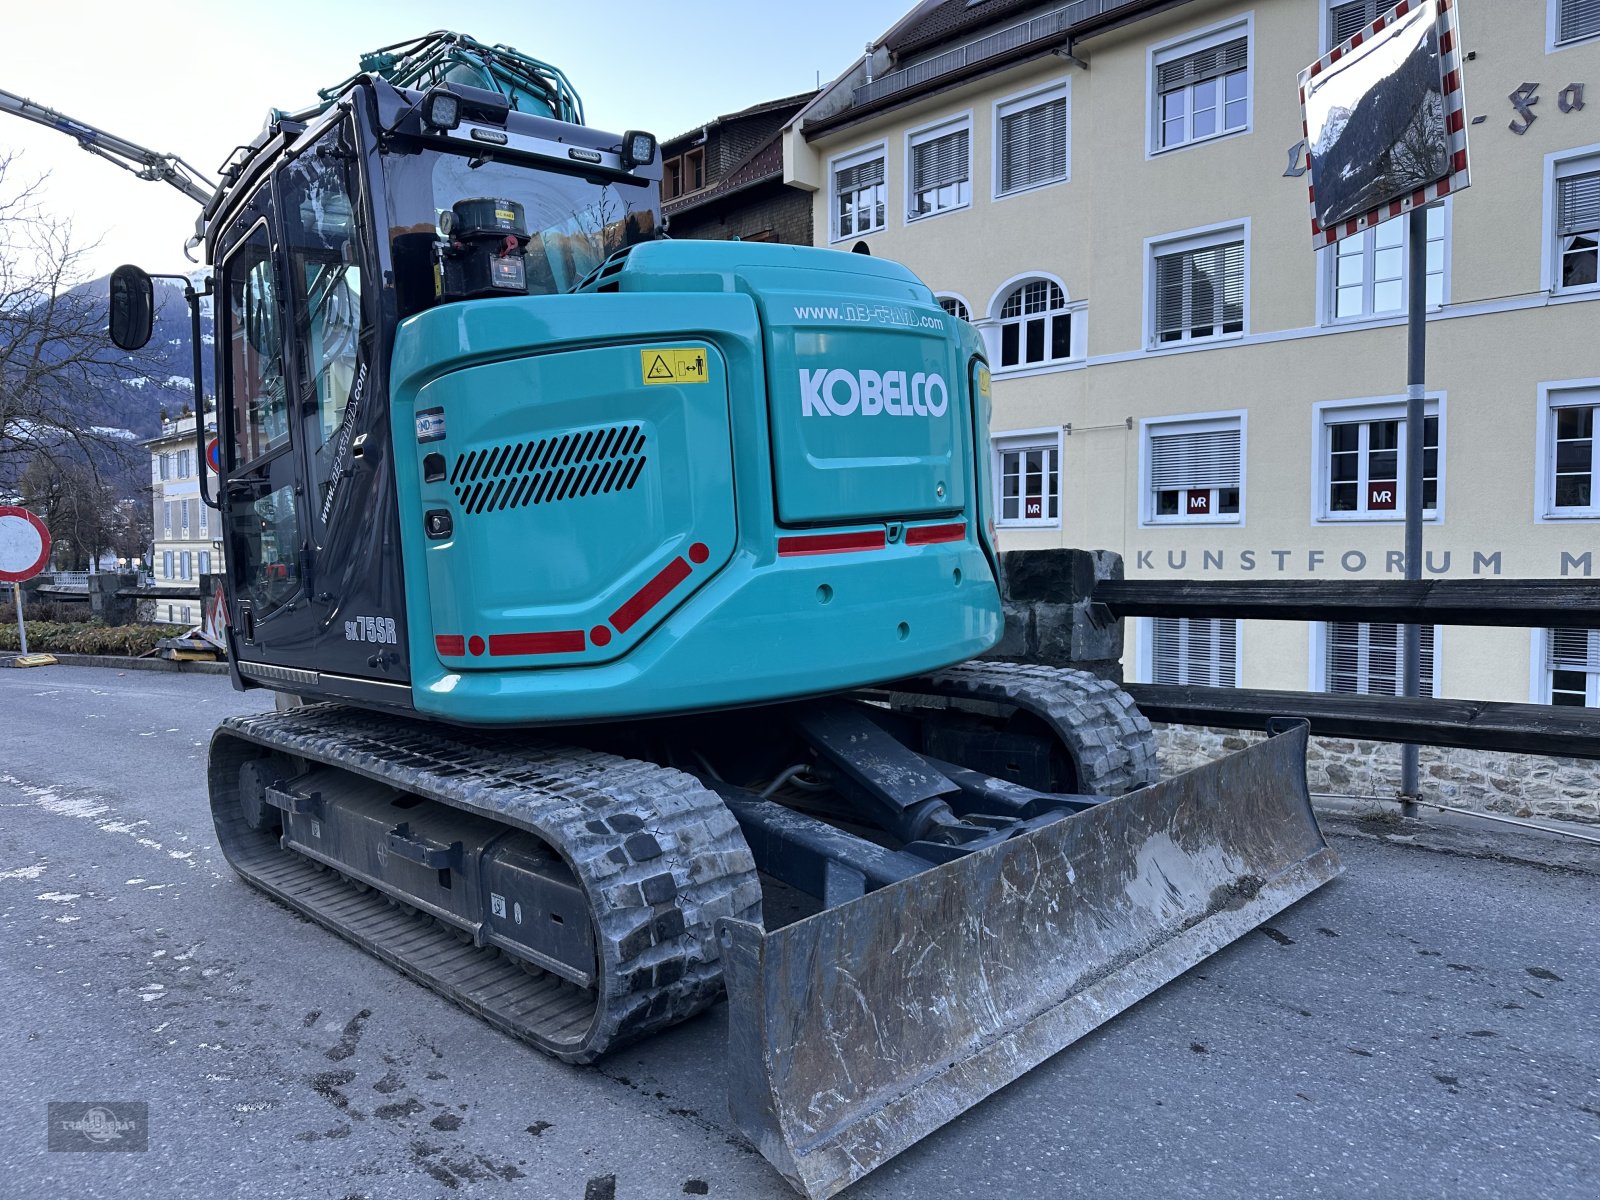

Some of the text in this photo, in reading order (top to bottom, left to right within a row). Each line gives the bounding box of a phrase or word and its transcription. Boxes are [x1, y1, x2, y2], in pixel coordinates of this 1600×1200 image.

[798, 368, 948, 418] KOBELCO
[1190, 496, 1207, 509] MR
[1372, 491, 1391, 504] MR
[1027, 503, 1040, 514] MR
[1136, 549, 1502, 575] KUNSTFORUM
